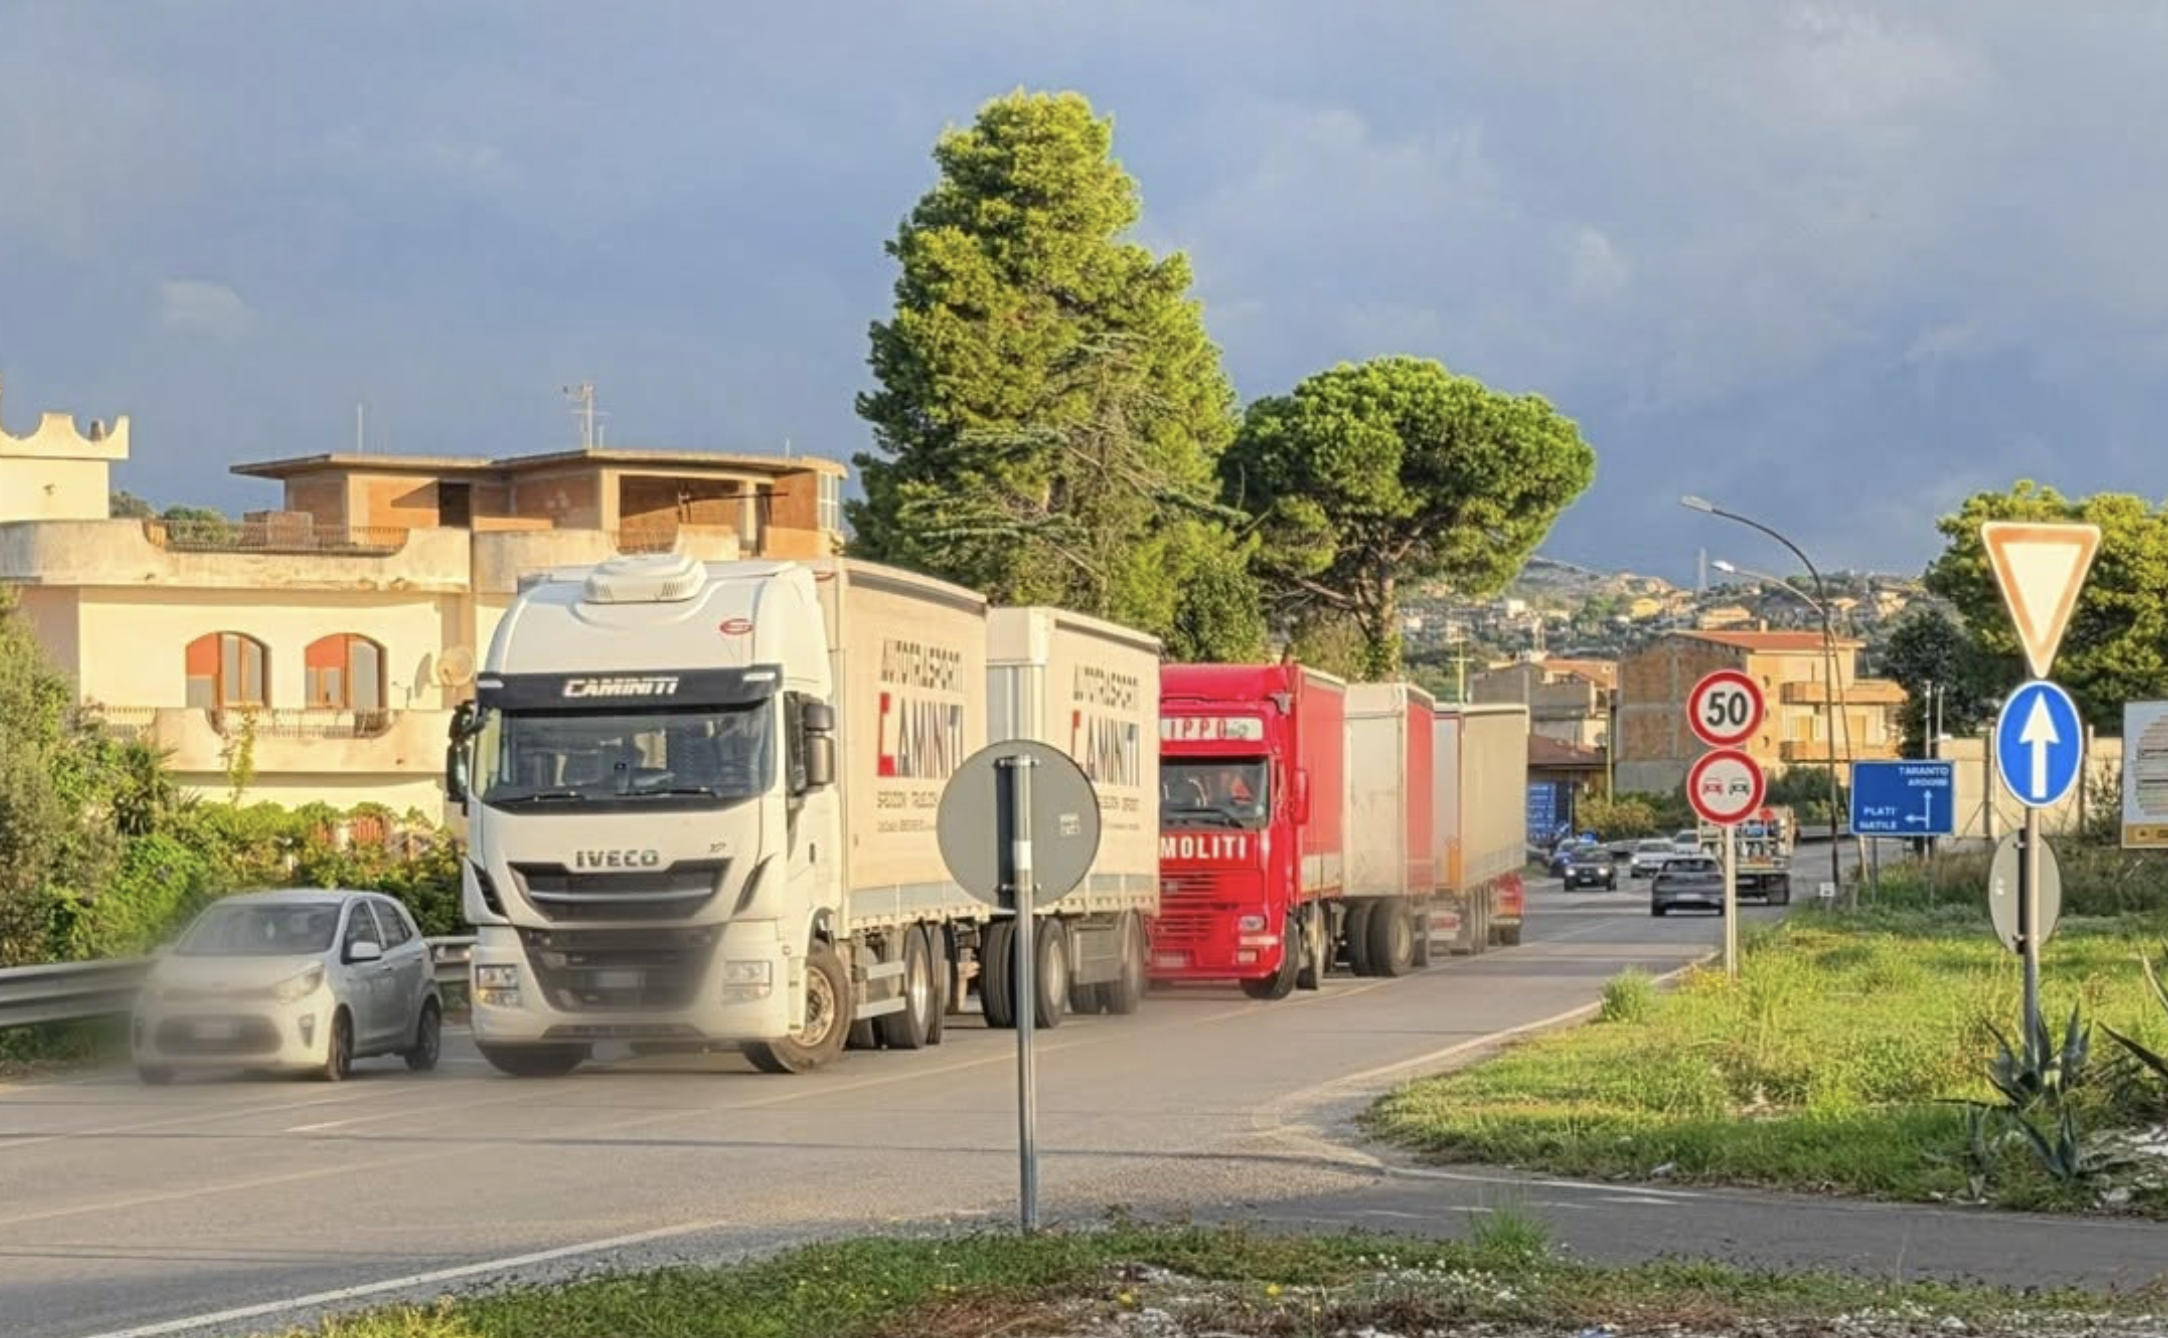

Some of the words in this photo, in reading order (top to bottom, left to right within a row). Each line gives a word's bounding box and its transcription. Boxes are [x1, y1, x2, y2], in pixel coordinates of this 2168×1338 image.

[562, 676, 679, 698] CAMINITI
[1707, 690, 1748, 727] 50
[575, 849, 659, 868] IVECO
[1160, 835, 1247, 860] MOLITI
